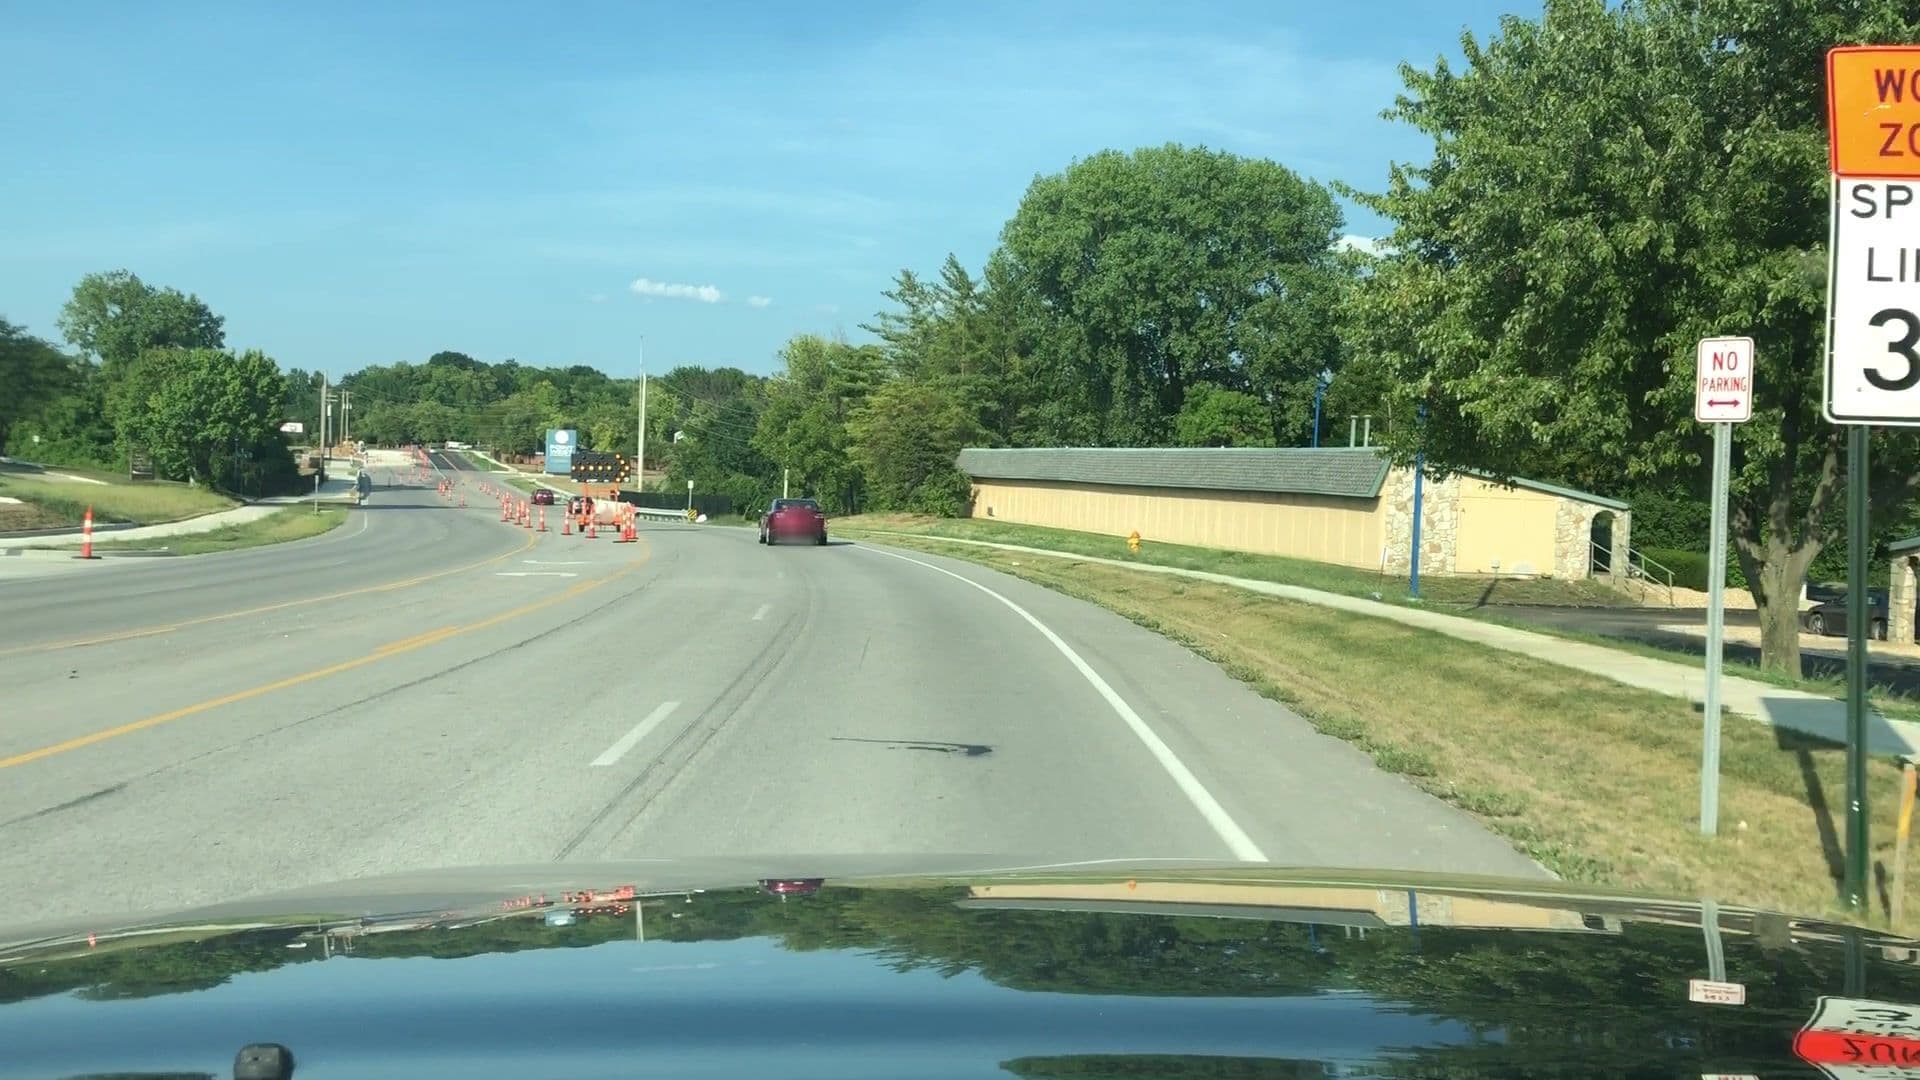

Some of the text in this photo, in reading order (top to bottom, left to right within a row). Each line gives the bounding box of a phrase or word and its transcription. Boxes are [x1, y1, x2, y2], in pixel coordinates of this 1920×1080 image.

[1867, 246, 1920, 283] LI
[1712, 351, 1738, 371] NO
[1863, 307, 1920, 391] 3
[1702, 376, 1747, 393] PARKING
